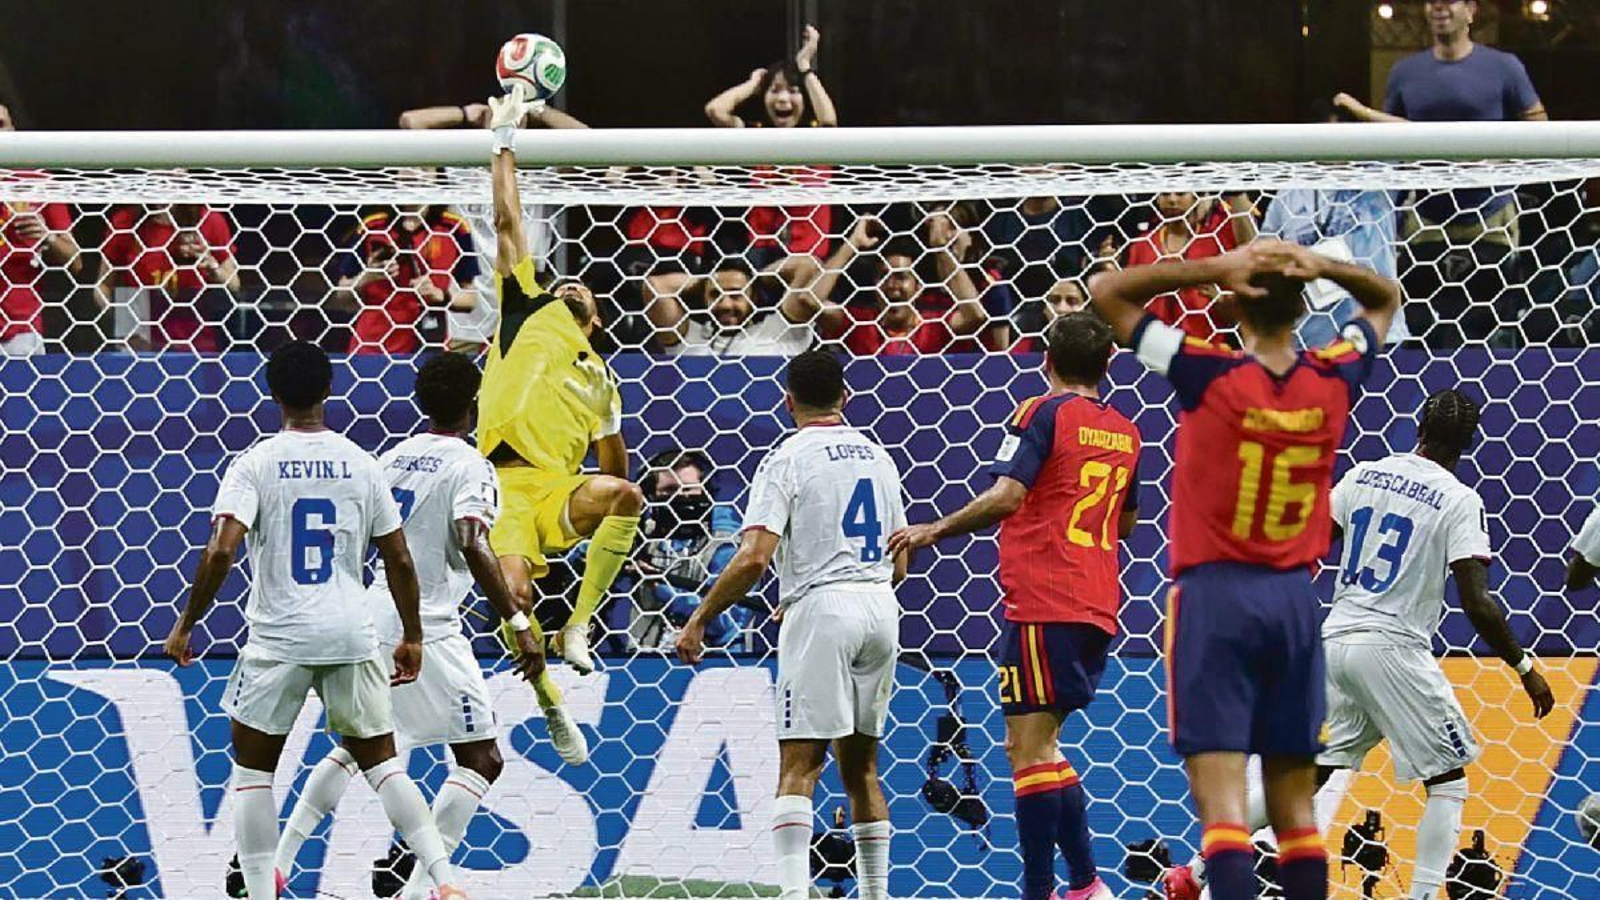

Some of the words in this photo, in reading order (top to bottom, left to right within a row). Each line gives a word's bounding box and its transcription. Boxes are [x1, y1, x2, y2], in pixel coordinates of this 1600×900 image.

[825, 444, 875, 461] LOPES
[1231, 441, 1322, 541] 16
[291, 498, 337, 585] 6
[841, 478, 882, 562] 4
[1066, 461, 1130, 550] 21
[1341, 506, 1414, 593] 13
[998, 666, 1022, 703] 21
[47, 667, 782, 900] VISA
